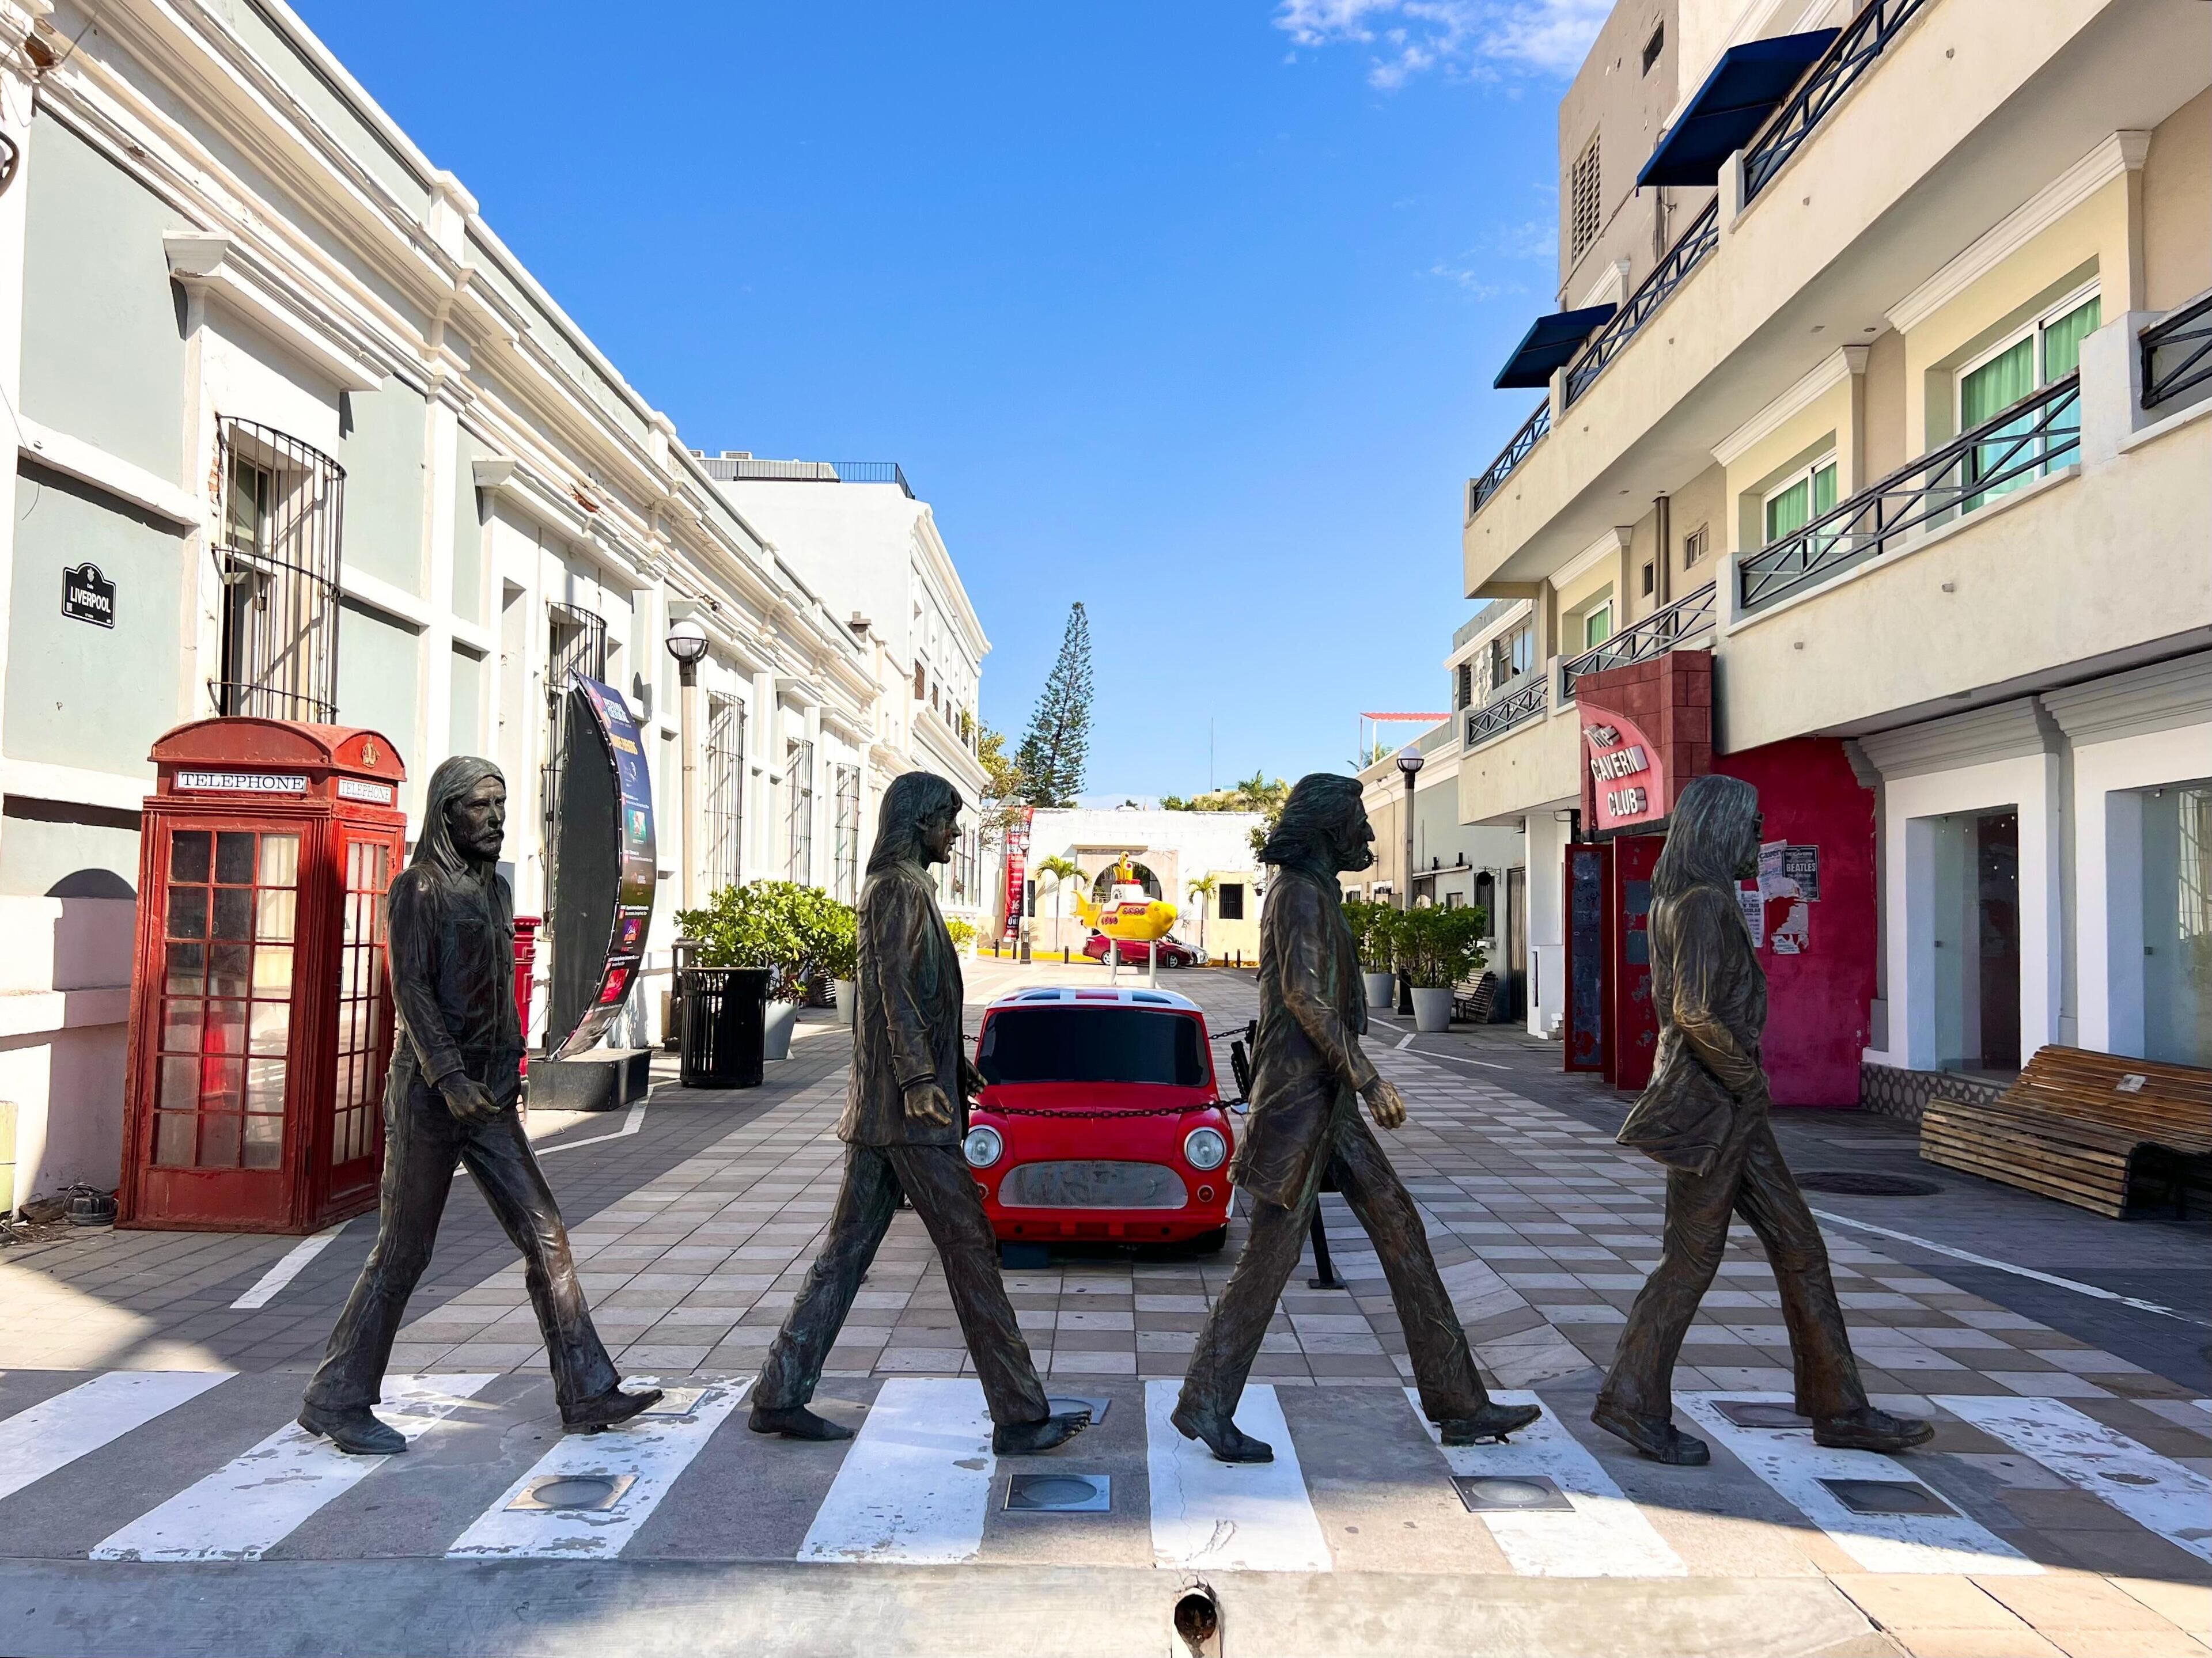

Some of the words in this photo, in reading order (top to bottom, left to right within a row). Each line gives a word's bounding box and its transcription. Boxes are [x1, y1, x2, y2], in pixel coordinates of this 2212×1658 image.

[70, 586, 111, 613] LIVERPOOL
[1583, 724, 1615, 749] The
[1591, 748, 1641, 782] CAVERN
[181, 773, 305, 790] TELEPHONE
[341, 780, 391, 801] TELEPHONE
[1608, 788, 1639, 817] CLUB
[1786, 863, 1816, 872] BEATLES
